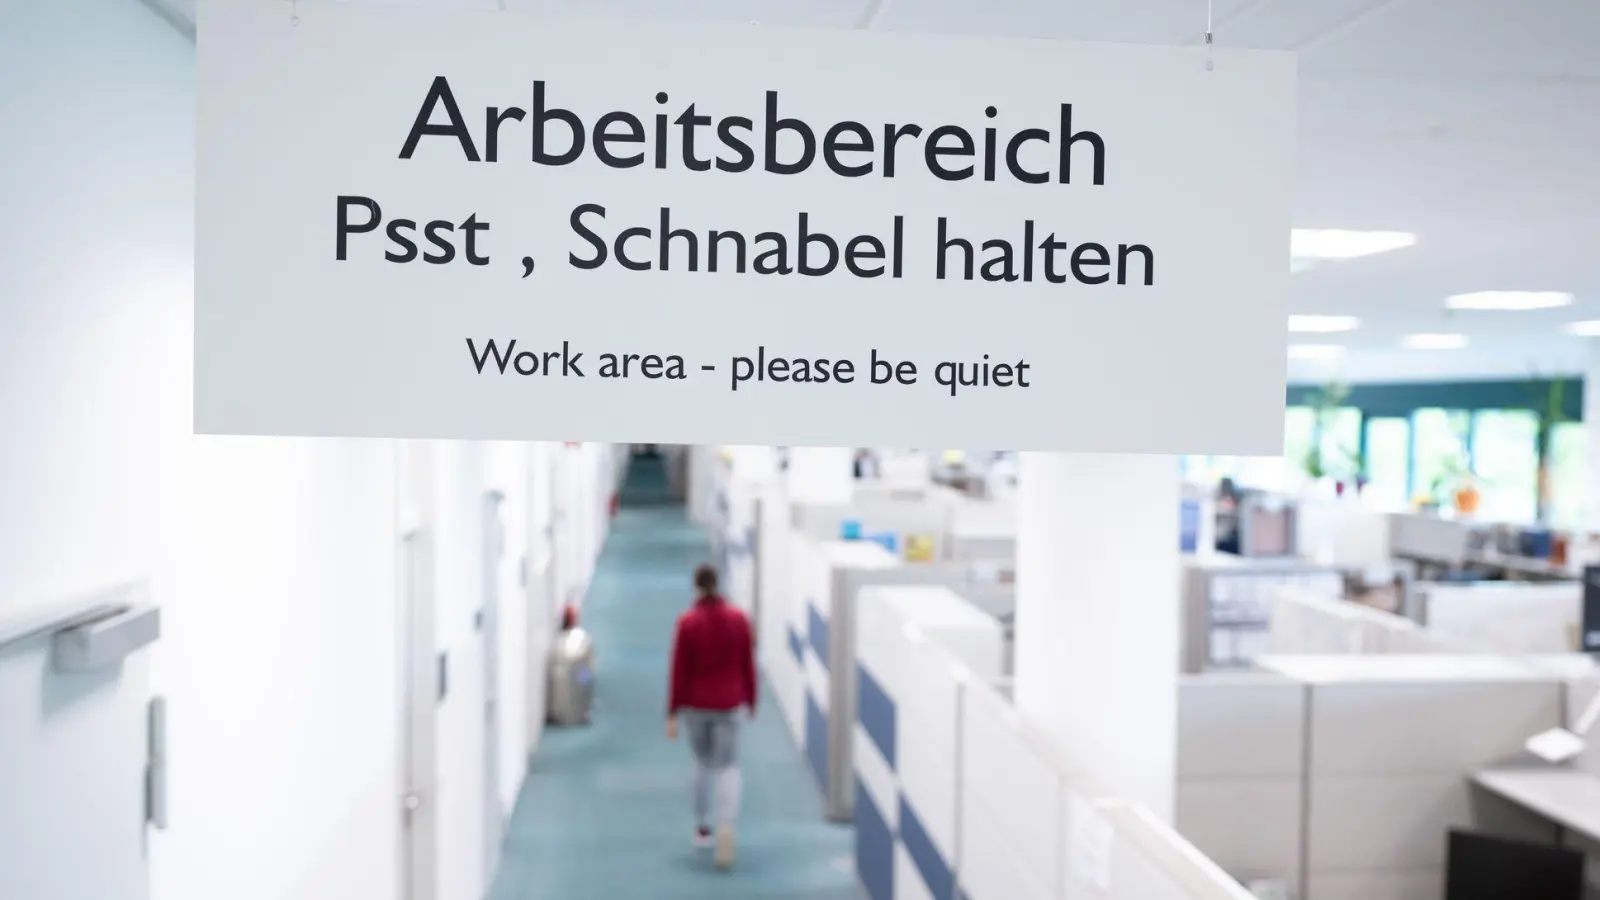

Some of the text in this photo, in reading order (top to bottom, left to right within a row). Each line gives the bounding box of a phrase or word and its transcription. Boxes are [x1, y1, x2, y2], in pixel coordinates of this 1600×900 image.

[398, 75, 1106, 186] Arbeitsbereich
[335, 195, 490, 266] Psst
[569, 203, 904, 279] Schnabel
[936, 216, 1154, 286] halten
[465, 337, 585, 377] Work
[598, 353, 688, 380] area
[731, 345, 855, 392] please
[870, 348, 918, 385] be
[934, 353, 1031, 397] quiet
